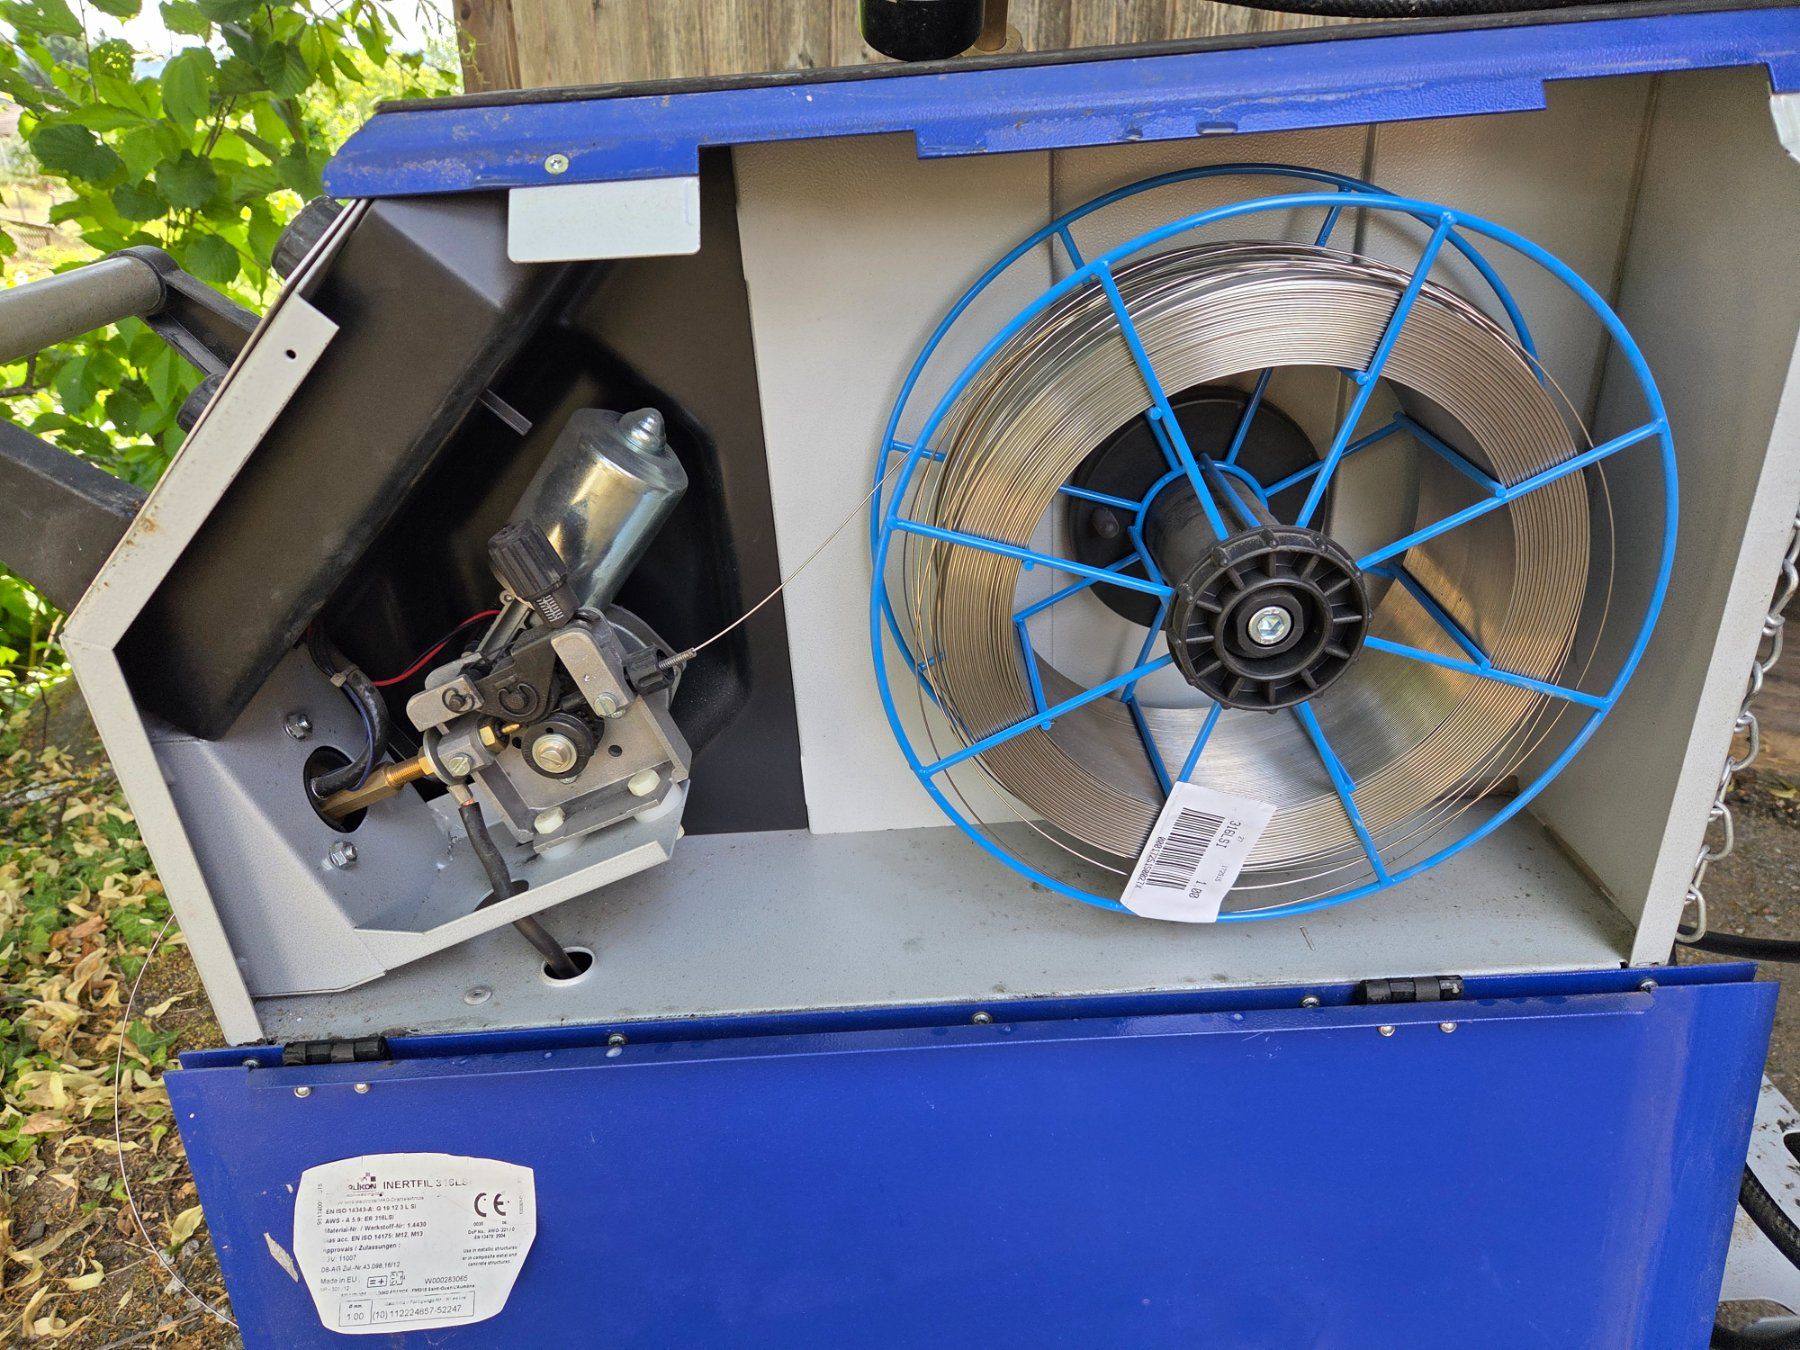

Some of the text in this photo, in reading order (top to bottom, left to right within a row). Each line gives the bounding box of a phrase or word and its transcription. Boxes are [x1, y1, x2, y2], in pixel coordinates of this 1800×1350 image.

[1216, 820, 1241, 848] 316LSI
[383, 1180, 433, 1190] INERTFIL
[410, 1230, 424, 1238] M13
[358, 1243, 397, 1251] Zulassungen
[372, 1311, 388, 1320] (10)
